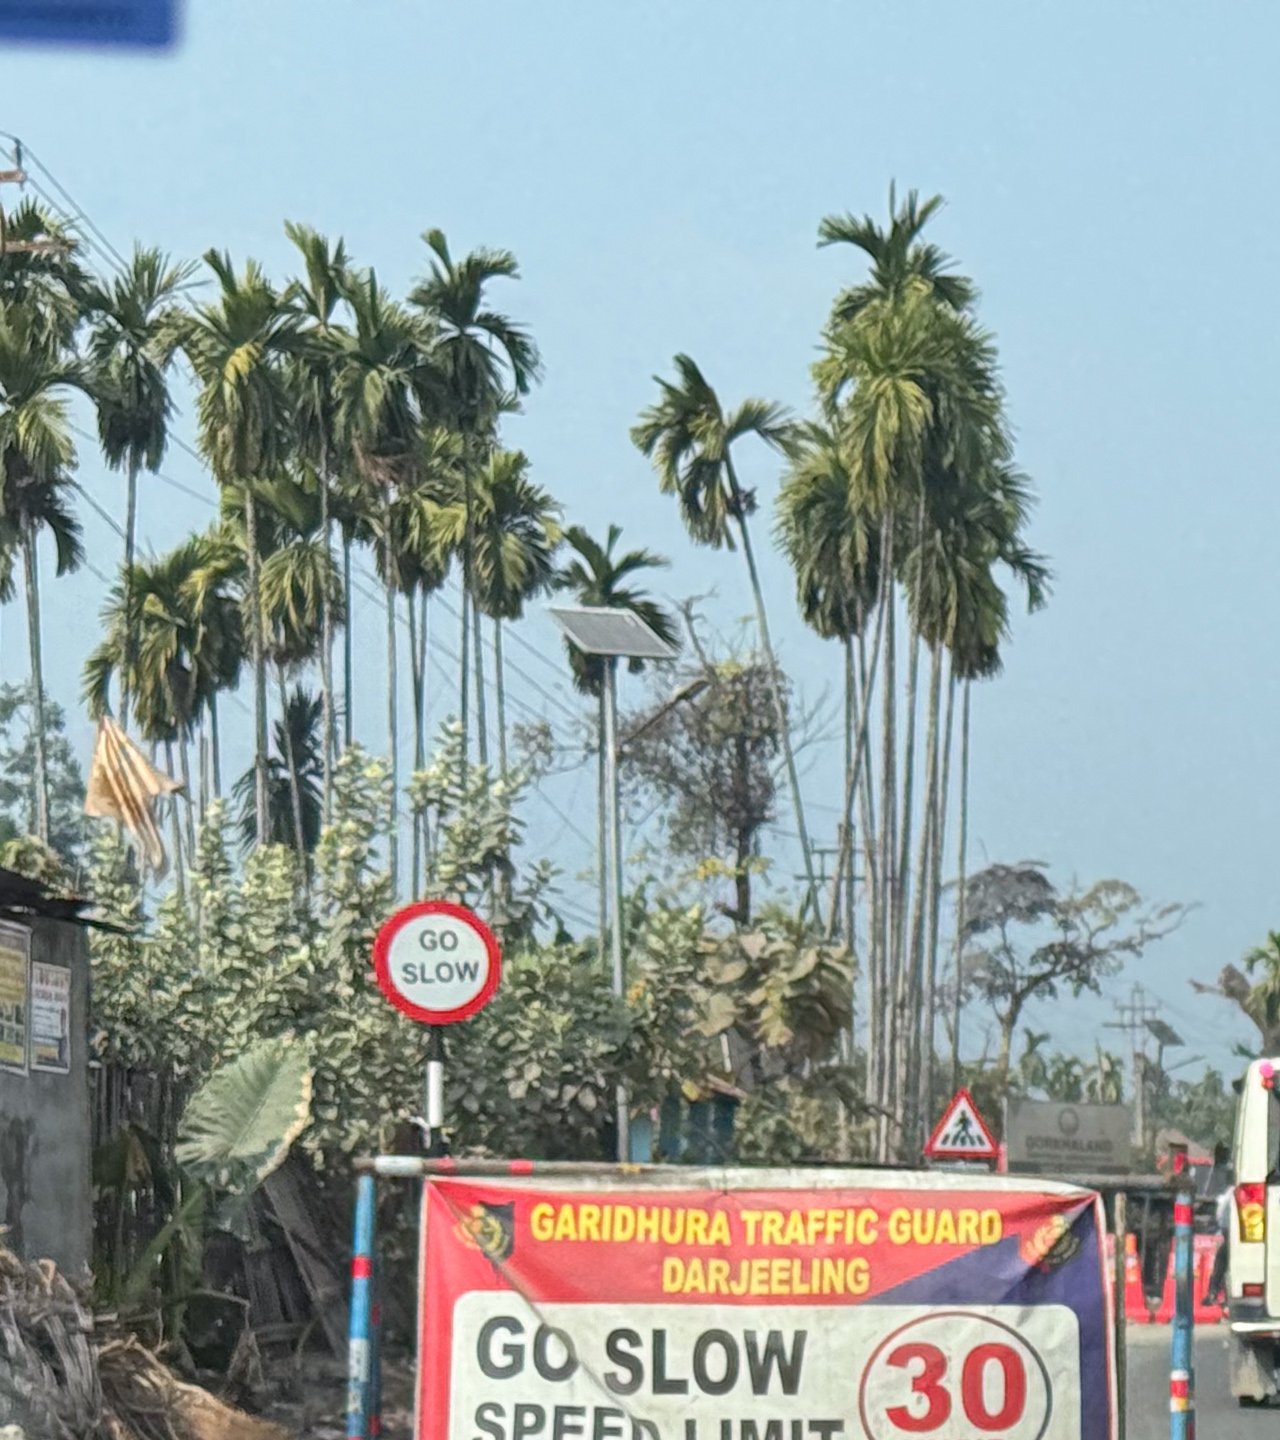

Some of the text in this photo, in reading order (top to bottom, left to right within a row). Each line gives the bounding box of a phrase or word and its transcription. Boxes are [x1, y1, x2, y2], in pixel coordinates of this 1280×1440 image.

[419, 930, 458, 951] GO
[402, 961, 480, 984] SLOW
[530, 1203, 1003, 1247] GARIDHURA TRAFFIC GUARD
[661, 1255, 871, 1296] DARJEELING
[475, 1314, 808, 1396] GO SLOW
[885, 1342, 1027, 1434] 30
